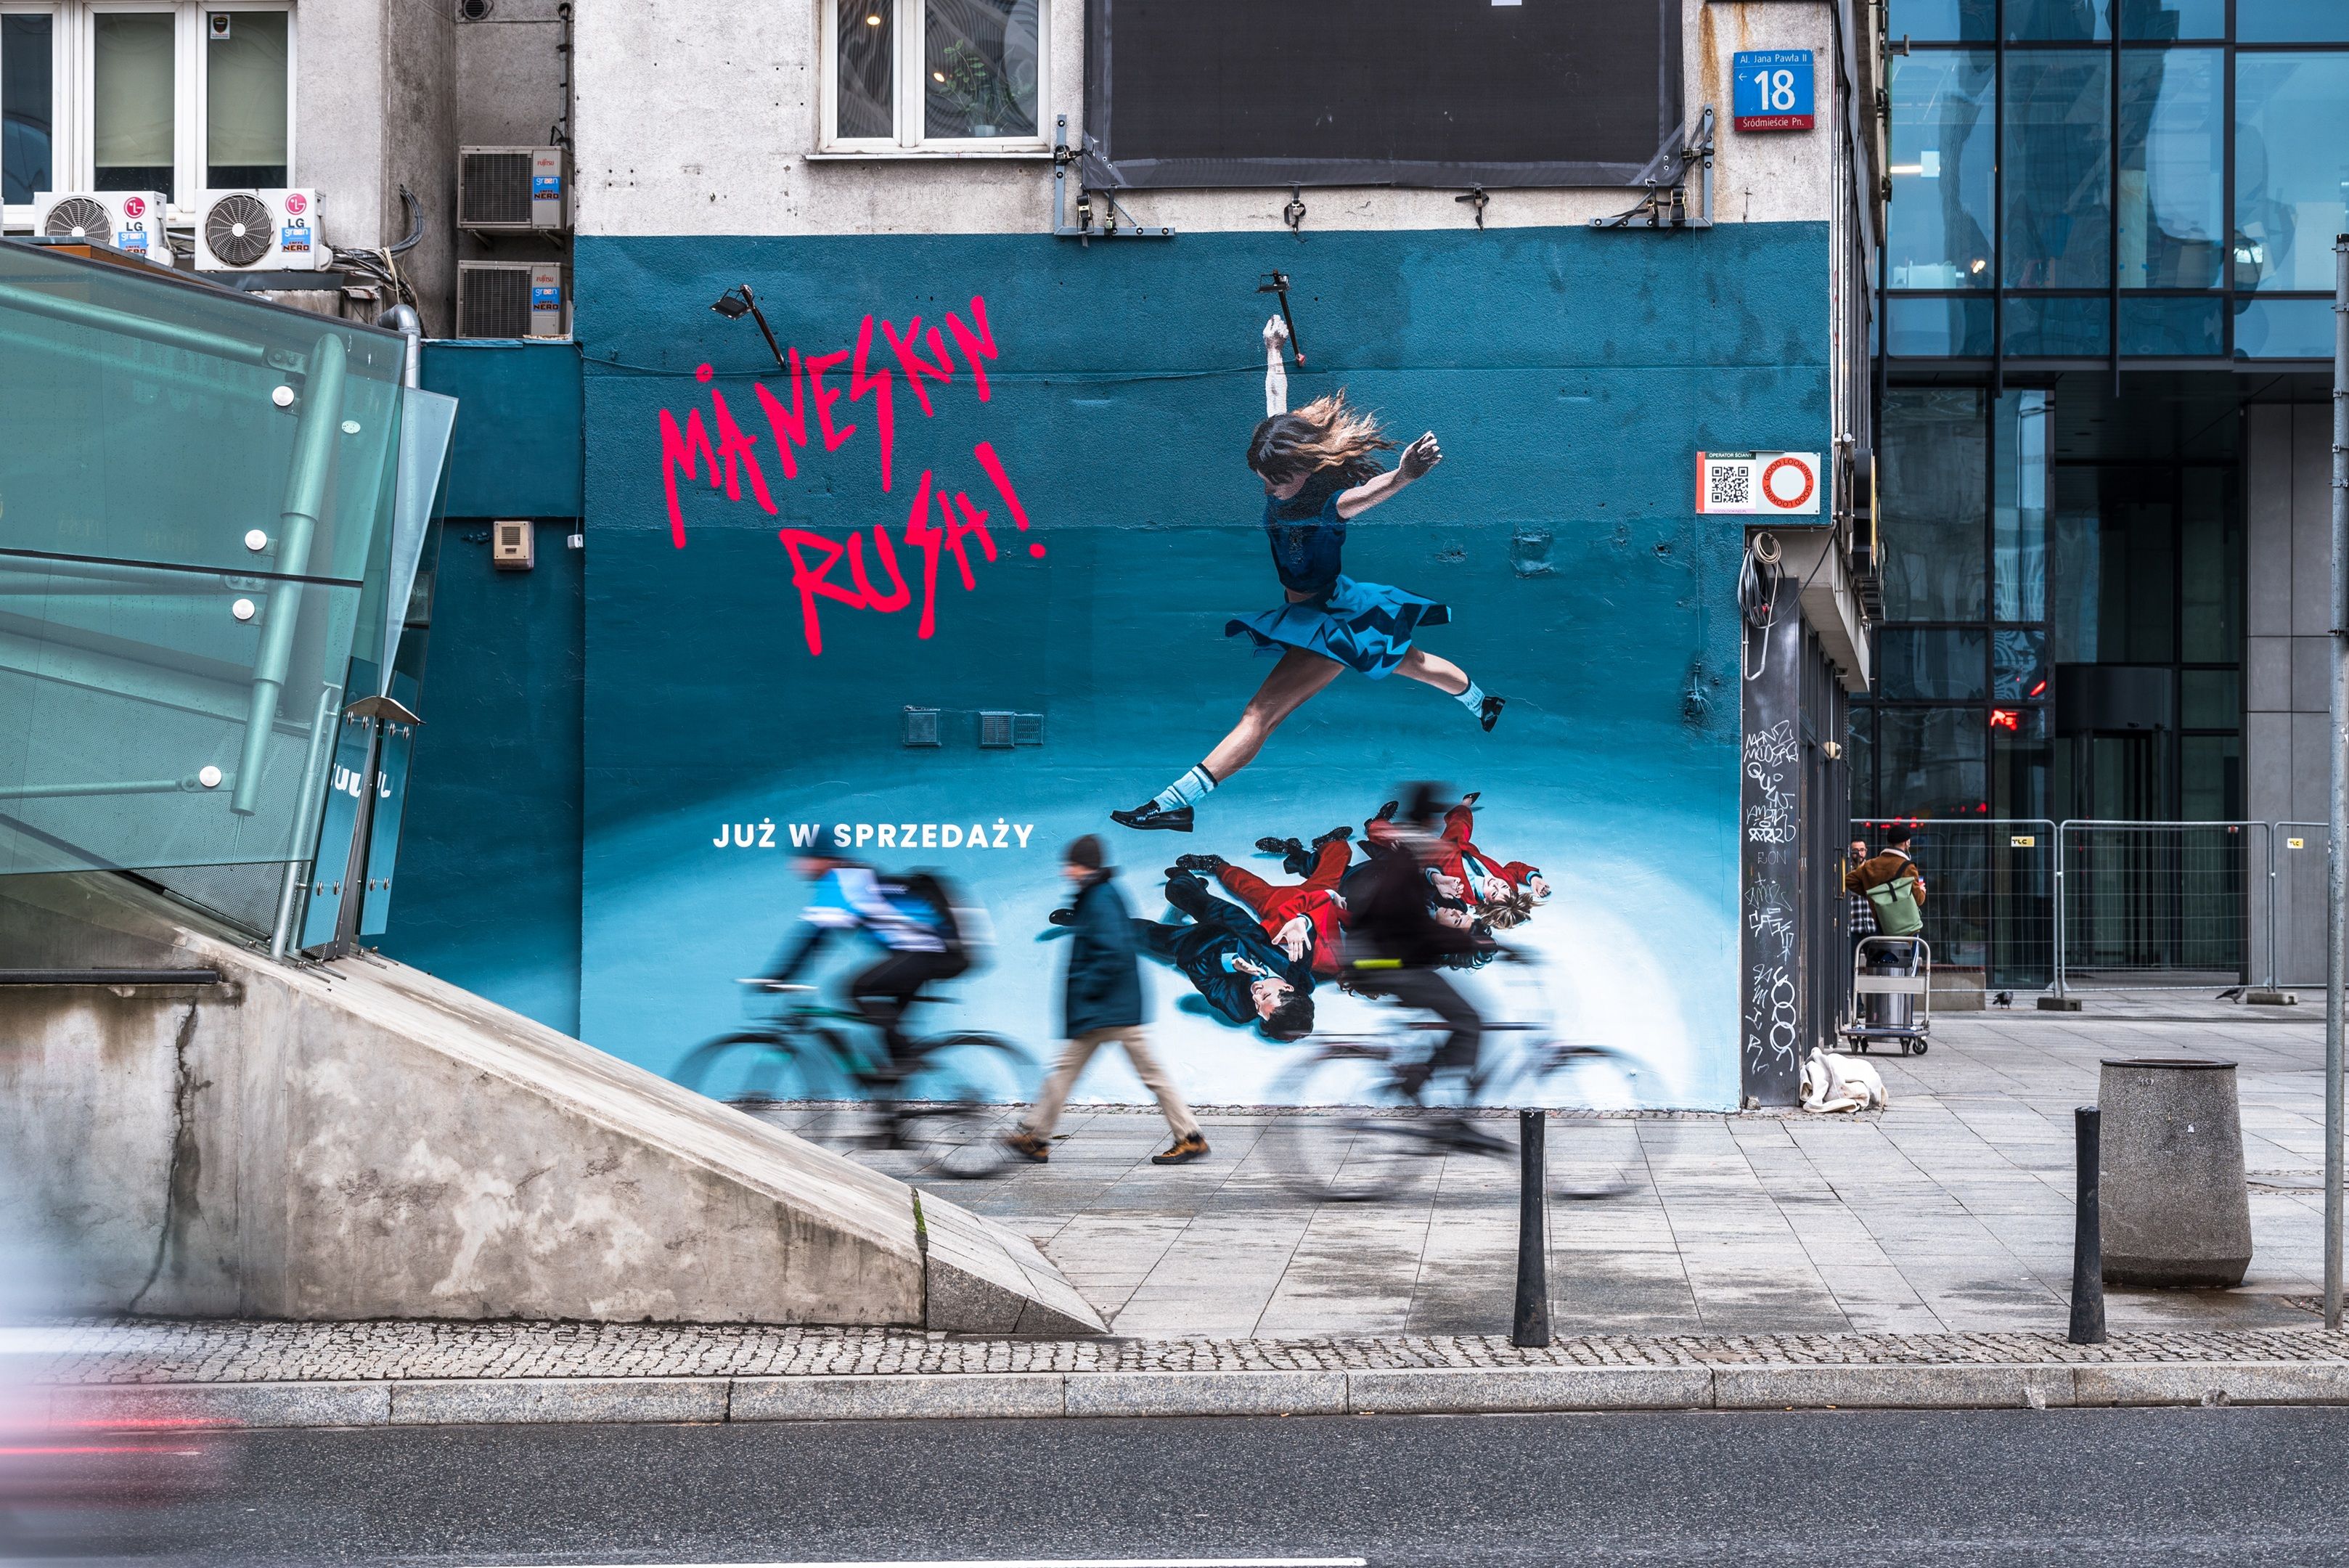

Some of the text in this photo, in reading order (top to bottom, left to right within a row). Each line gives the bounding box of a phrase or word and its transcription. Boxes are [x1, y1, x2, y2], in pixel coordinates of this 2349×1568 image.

[1740, 54, 1750, 63] Al.
[1775, 54, 1799, 62] Pawła
[1754, 69, 1796, 110] 18
[1743, 117, 1805, 128] Śródmieście Pn.
[126, 221, 143, 232] LG
[288, 218, 305, 228] LG
[1764, 458, 1813, 481] GOOD LOOKING
[1764, 485, 1813, 507] GOOD LOOKING
[779, 441, 1046, 656] RUSH!
[713, 817, 1034, 849] JUŻ W SPRZEDAŻY
